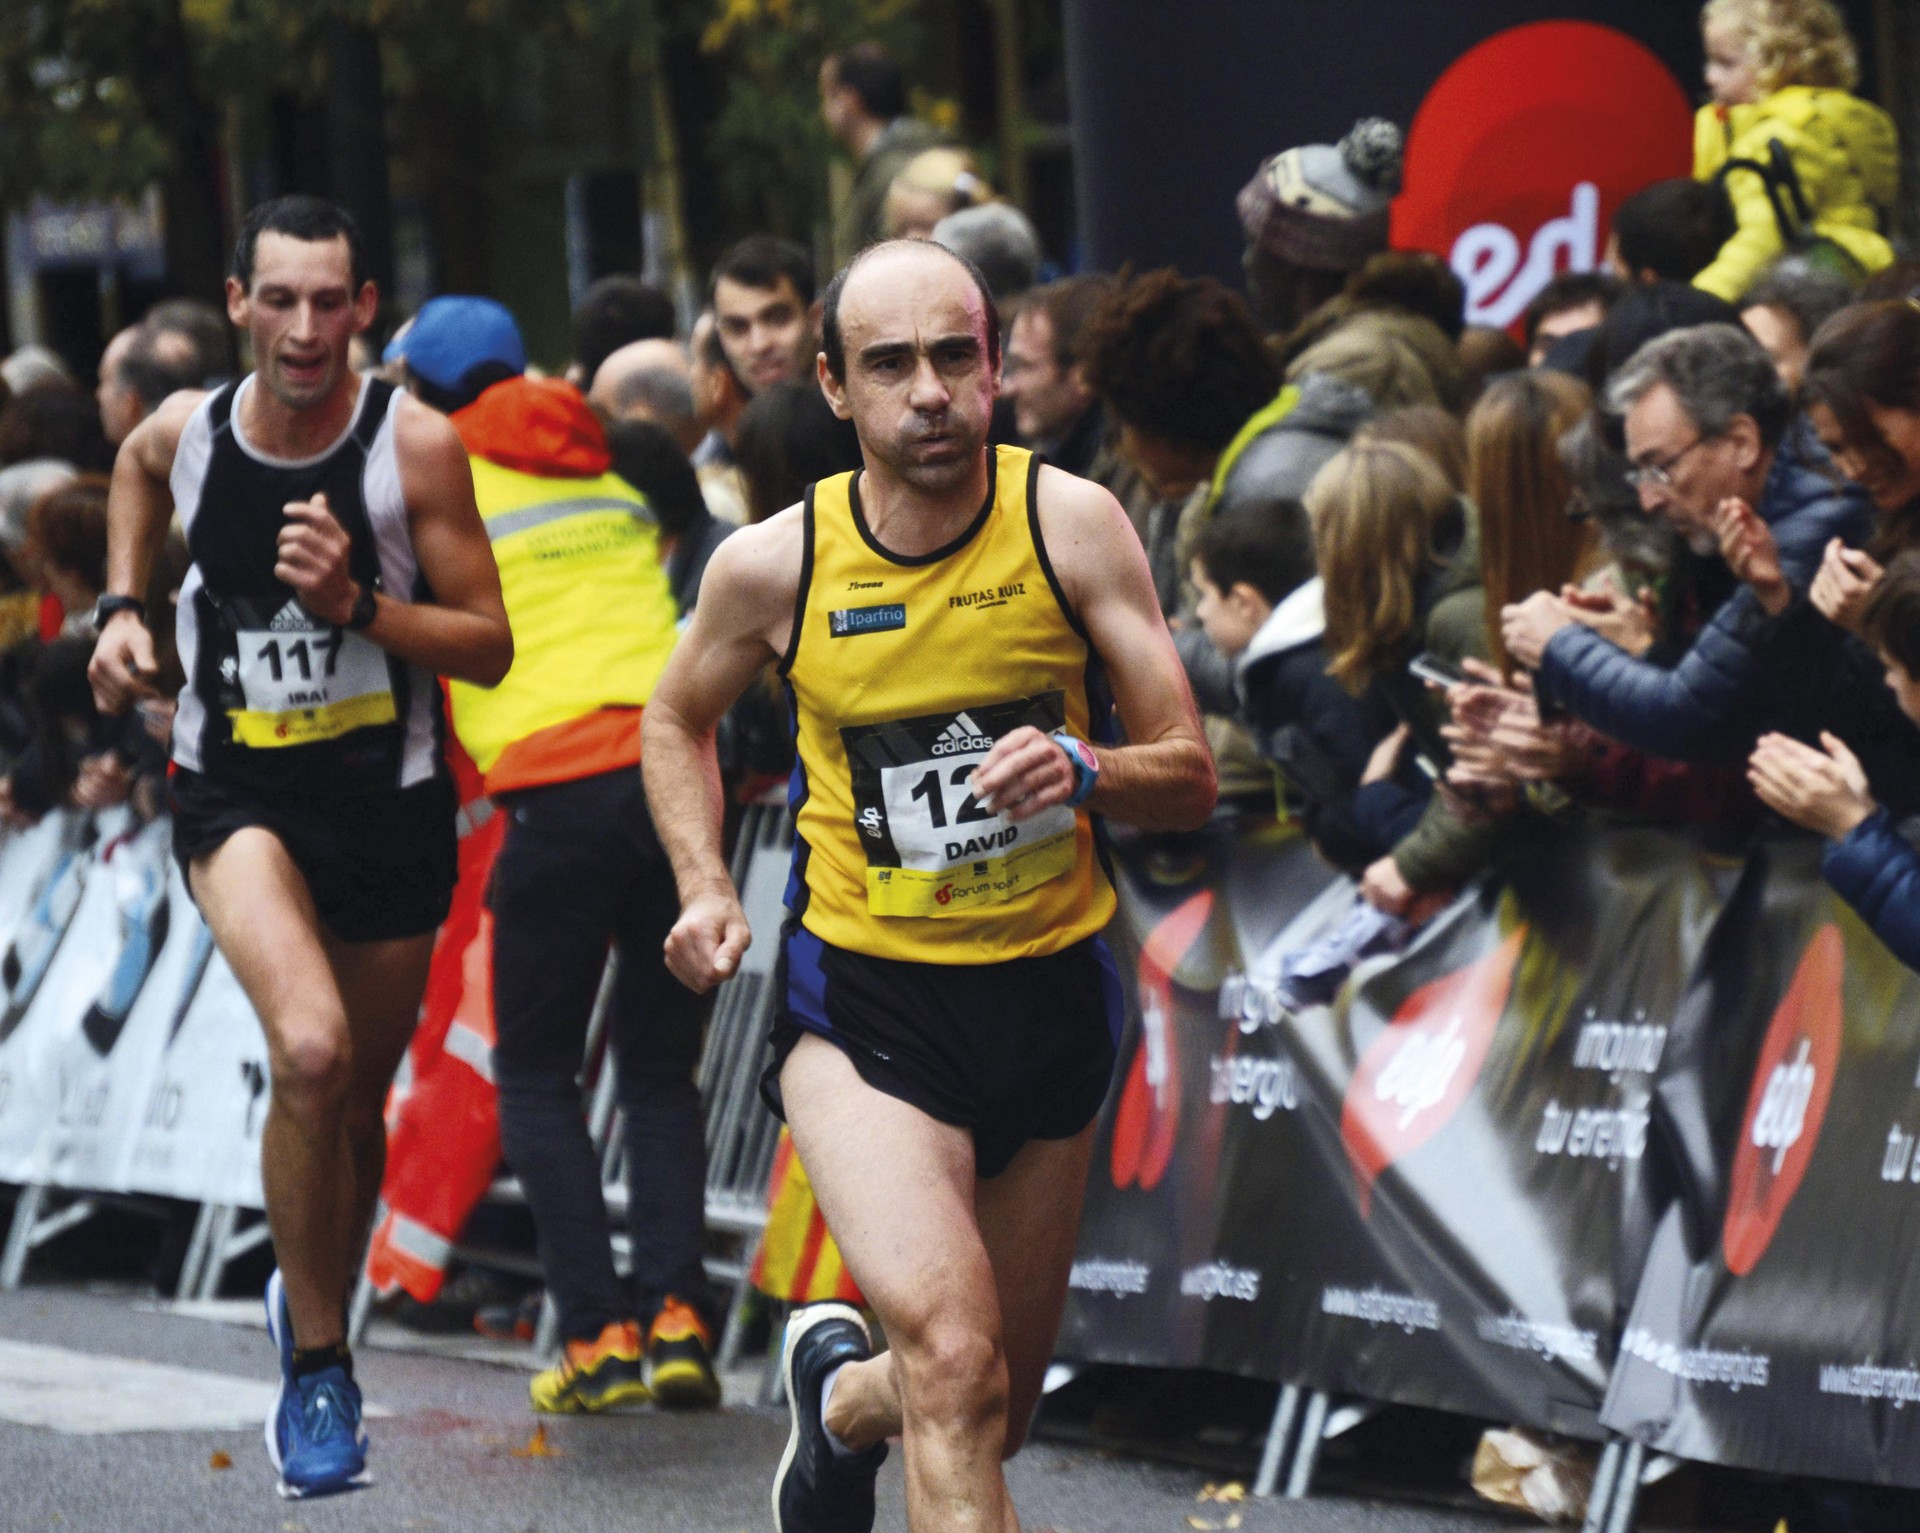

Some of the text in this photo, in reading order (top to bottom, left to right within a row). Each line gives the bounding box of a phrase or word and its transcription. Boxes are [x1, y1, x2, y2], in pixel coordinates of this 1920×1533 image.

[1450, 181, 1617, 328] ed
[949, 589, 995, 608] FRUTAS
[998, 583, 1026, 598] RUIZ
[257, 638, 343, 682] 117
[931, 736, 994, 755] adidas
[858, 807, 883, 839] edp
[945, 826, 1018, 861] DAVID
